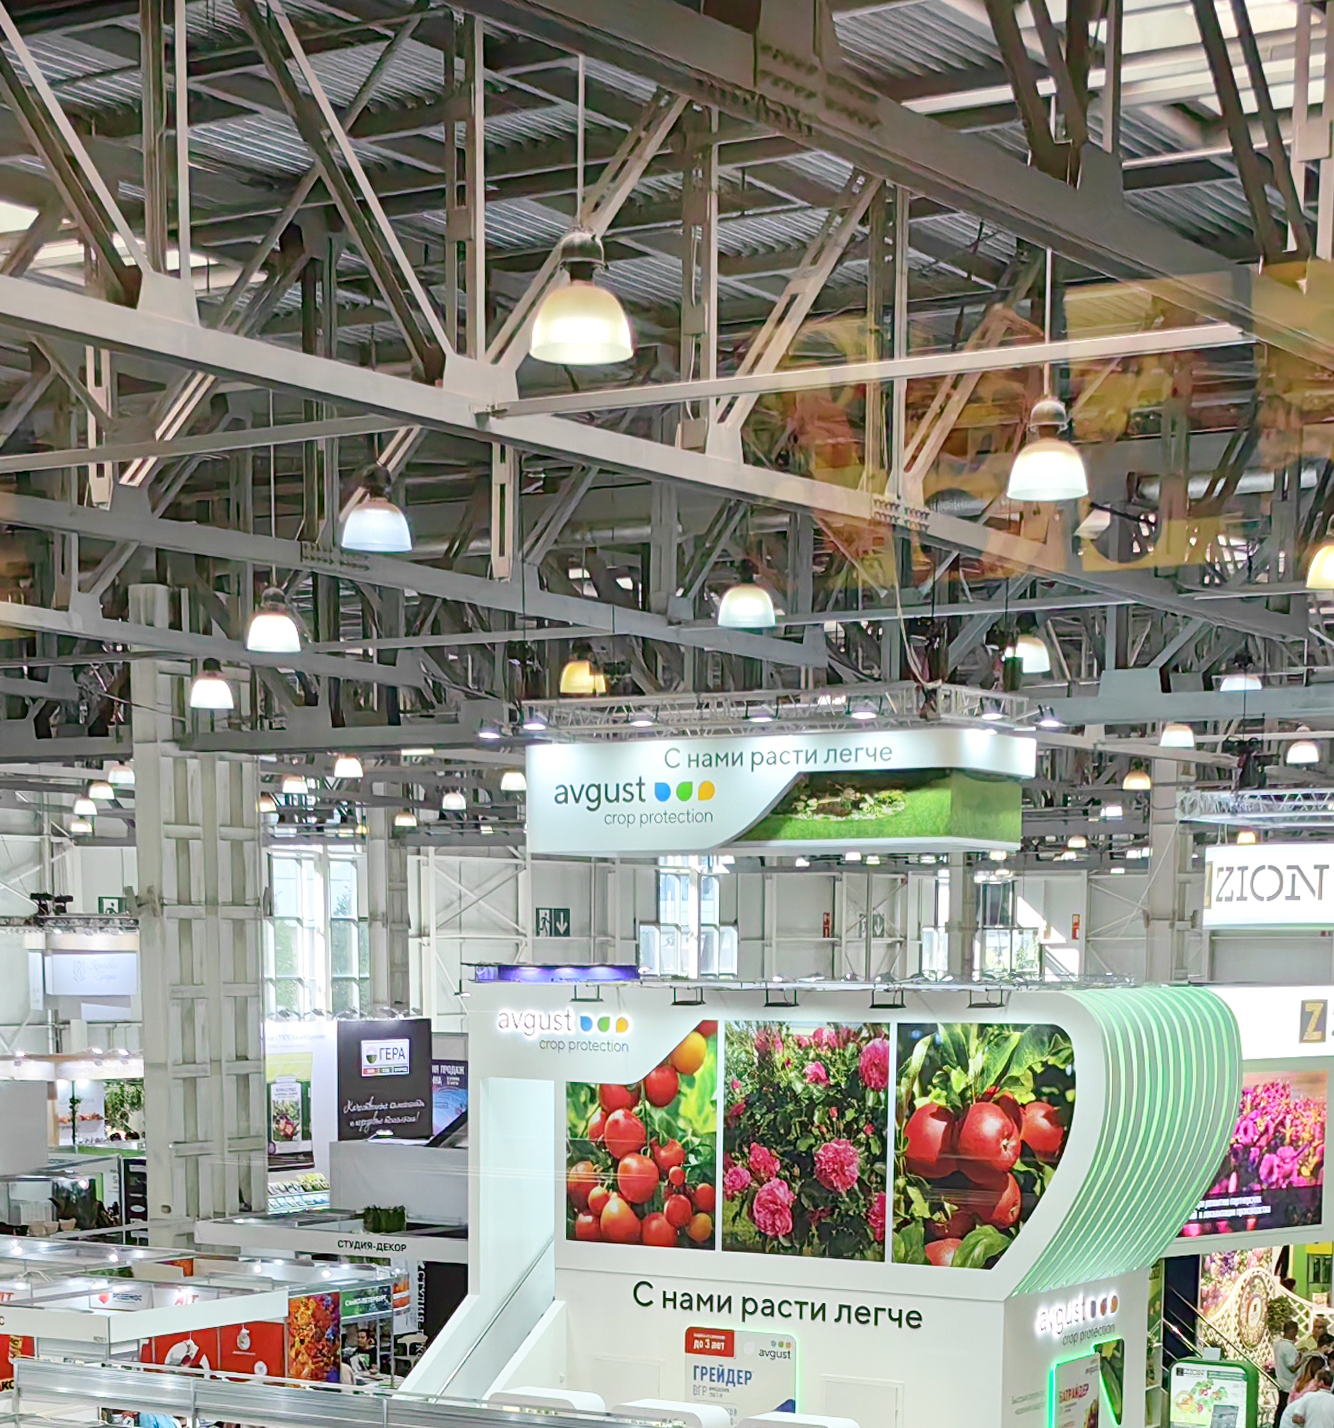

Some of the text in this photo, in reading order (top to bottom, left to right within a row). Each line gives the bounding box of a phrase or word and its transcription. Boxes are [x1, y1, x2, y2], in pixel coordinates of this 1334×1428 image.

[664, 742, 893, 772] С нами расти легче
[553, 775, 646, 812] avgust
[604, 807, 714, 827] crop protection
[1216, 864, 1330, 902] ZION
[497, 1007, 573, 1035] avgust
[378, 1046, 406, 1061] ГЕРА
[539, 1037, 629, 1053] crop protection
[337, 1239, 407, 1252] СТУДИЯ-ДЕКОР
[632, 1281, 924, 1331] С нами расти легче
[1062, 1323, 1116, 1346] crop protection
[758, 1348, 792, 1360] avgust
[692, 1364, 753, 1388] ГРЕЙДЕР
